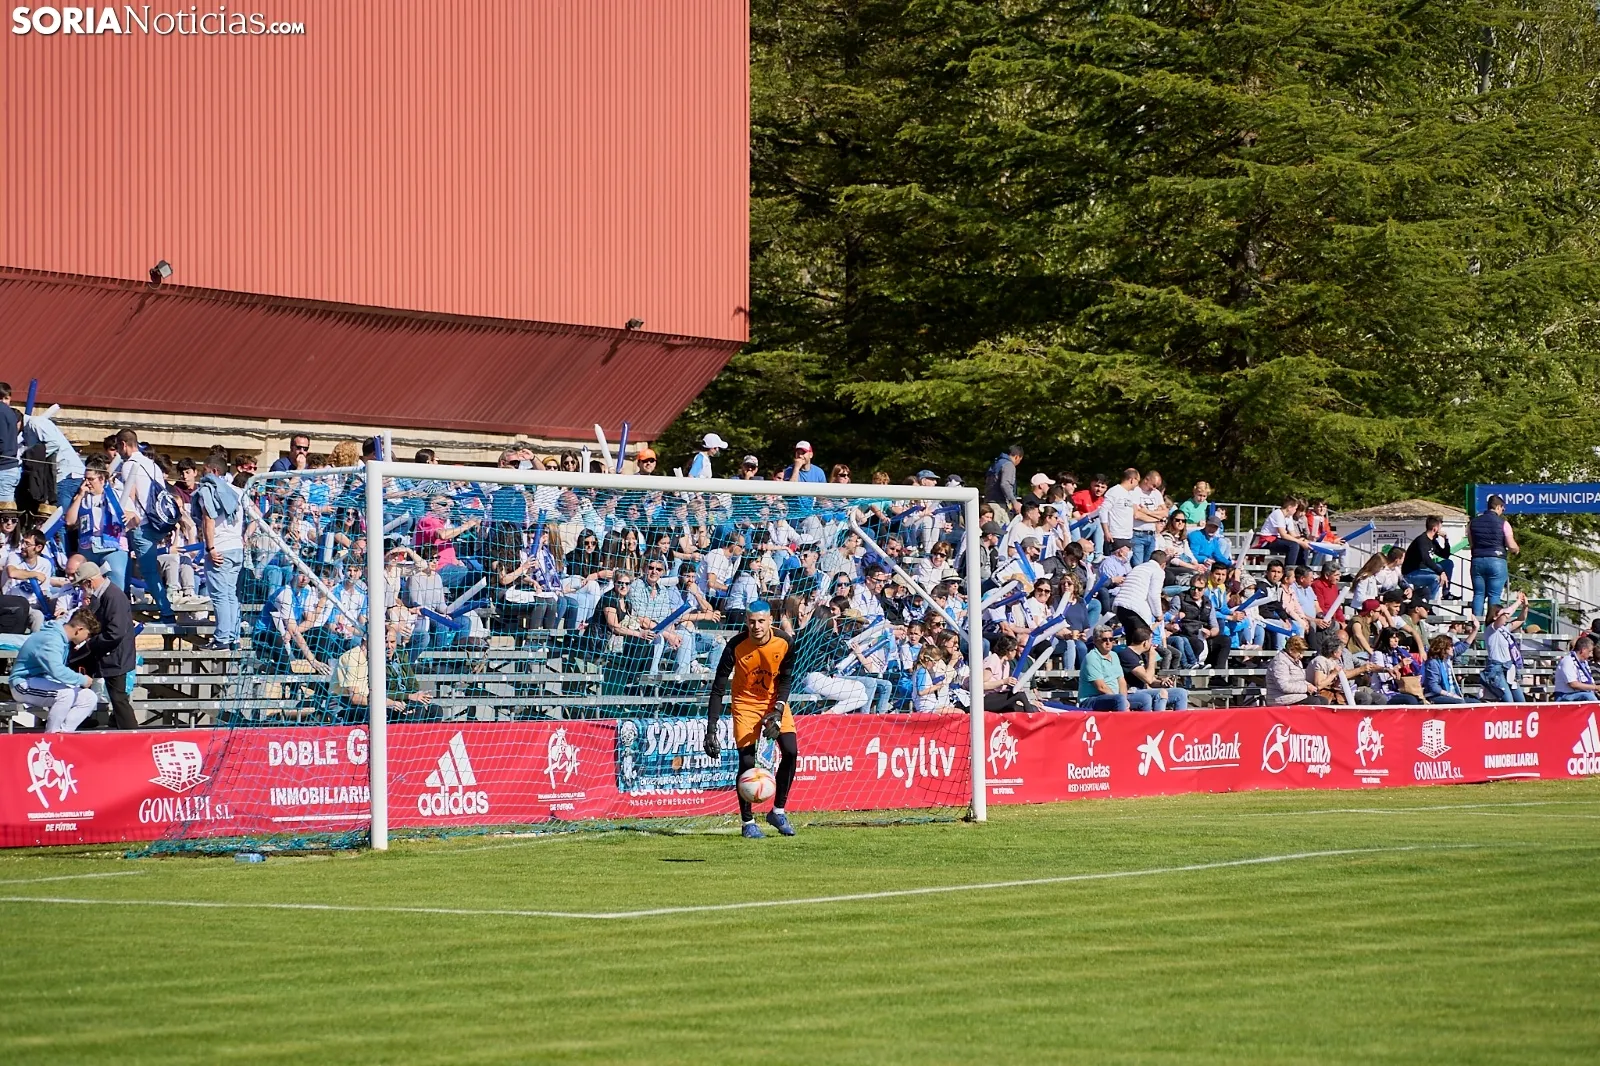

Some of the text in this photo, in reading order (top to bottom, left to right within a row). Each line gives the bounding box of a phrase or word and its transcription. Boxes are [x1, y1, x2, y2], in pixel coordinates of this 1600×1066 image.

[1484, 711, 1539, 740] DOBLE G
[268, 728, 368, 766] DOBLE G
[1169, 731, 1242, 763] CaixaBank
[1288, 733, 1331, 763] INTEGRA
[795, 755, 853, 772] omotive
[890, 737, 956, 789] cyltv
[1067, 761, 1110, 780] Recoletas
[1484, 753, 1539, 769] INMOBILIARIA
[270, 785, 370, 806] INMOBILIARIA
[1067, 781, 1110, 793] RED HOSPITALARIA
[417, 785, 489, 817] adidas
[45, 821, 77, 832] DE FÚTBOL
